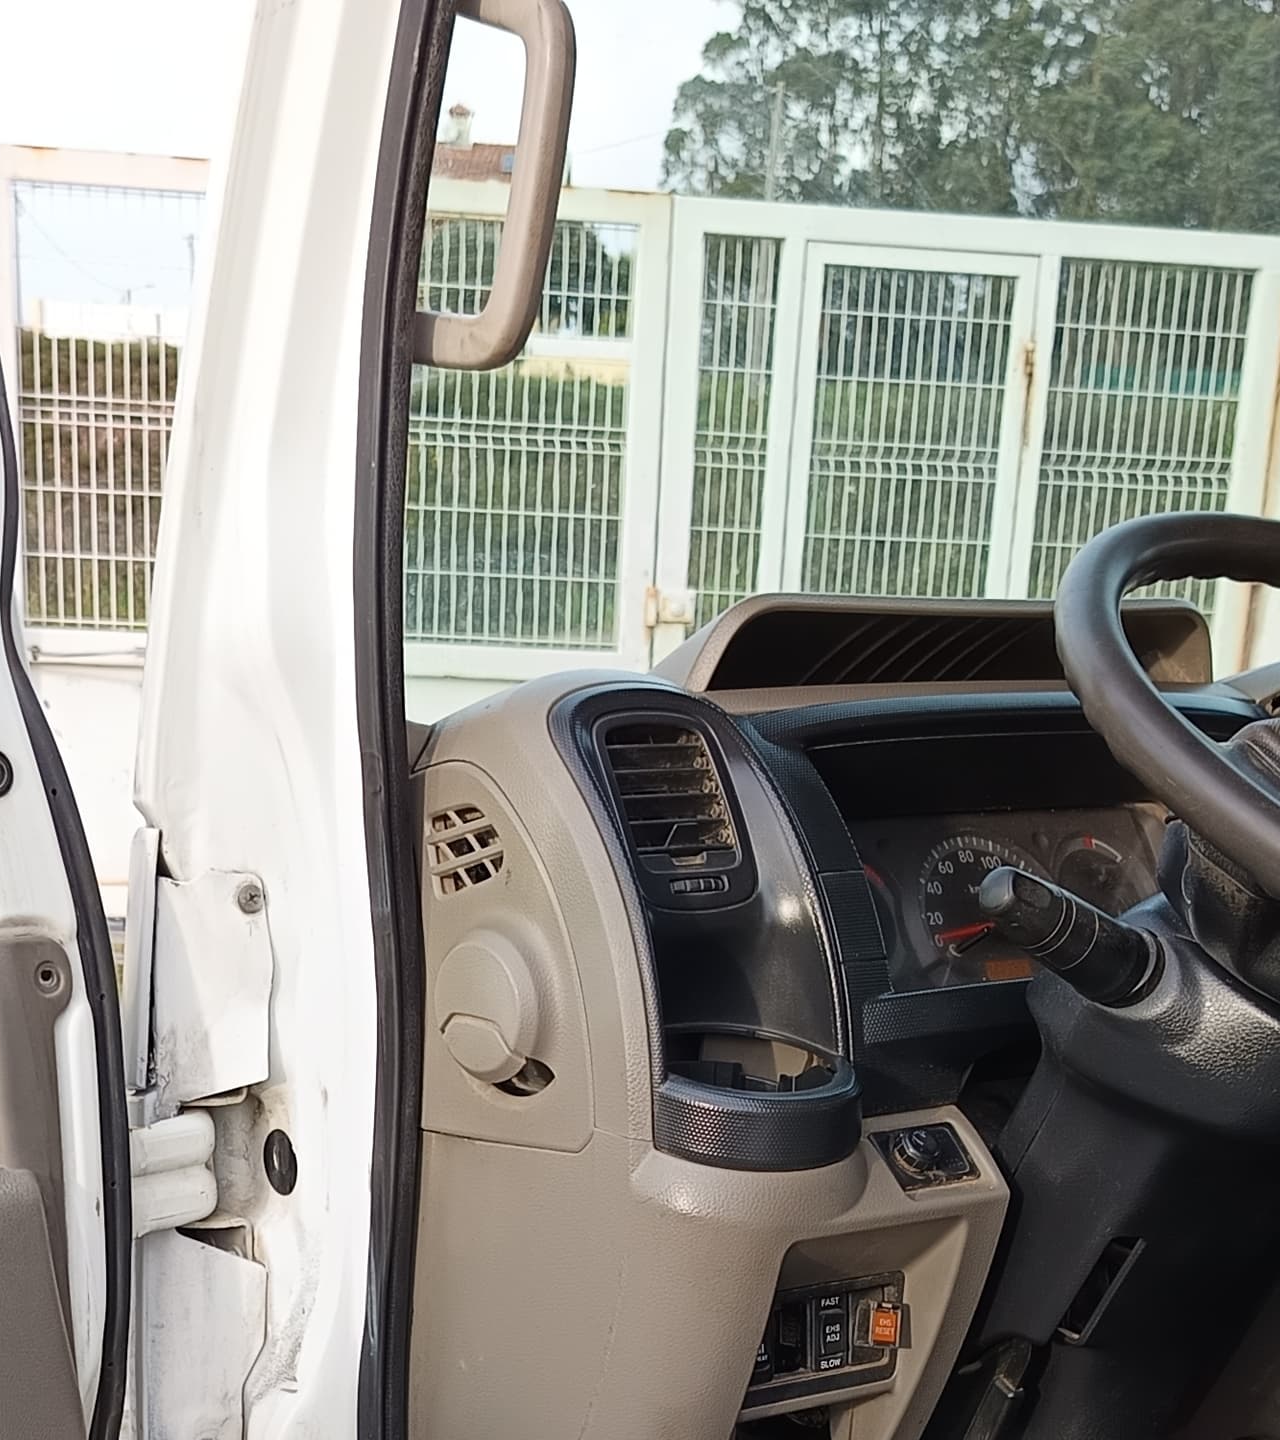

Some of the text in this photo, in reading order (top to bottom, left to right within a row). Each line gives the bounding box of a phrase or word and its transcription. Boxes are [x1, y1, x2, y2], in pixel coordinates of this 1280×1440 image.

[958, 850, 974, 863] 80
[980, 856, 1002, 869] 100
[938, 861, 953, 874] 60
[927, 881, 942, 895] 40
[927, 912, 943, 925] 20
[934, 934, 943, 947] 0
[821, 1297, 840, 1307] FAST
[875, 1327, 894, 1336] RESET
[826, 1334, 840, 1343] ADJ
[820, 1358, 841, 1369] SLOW
